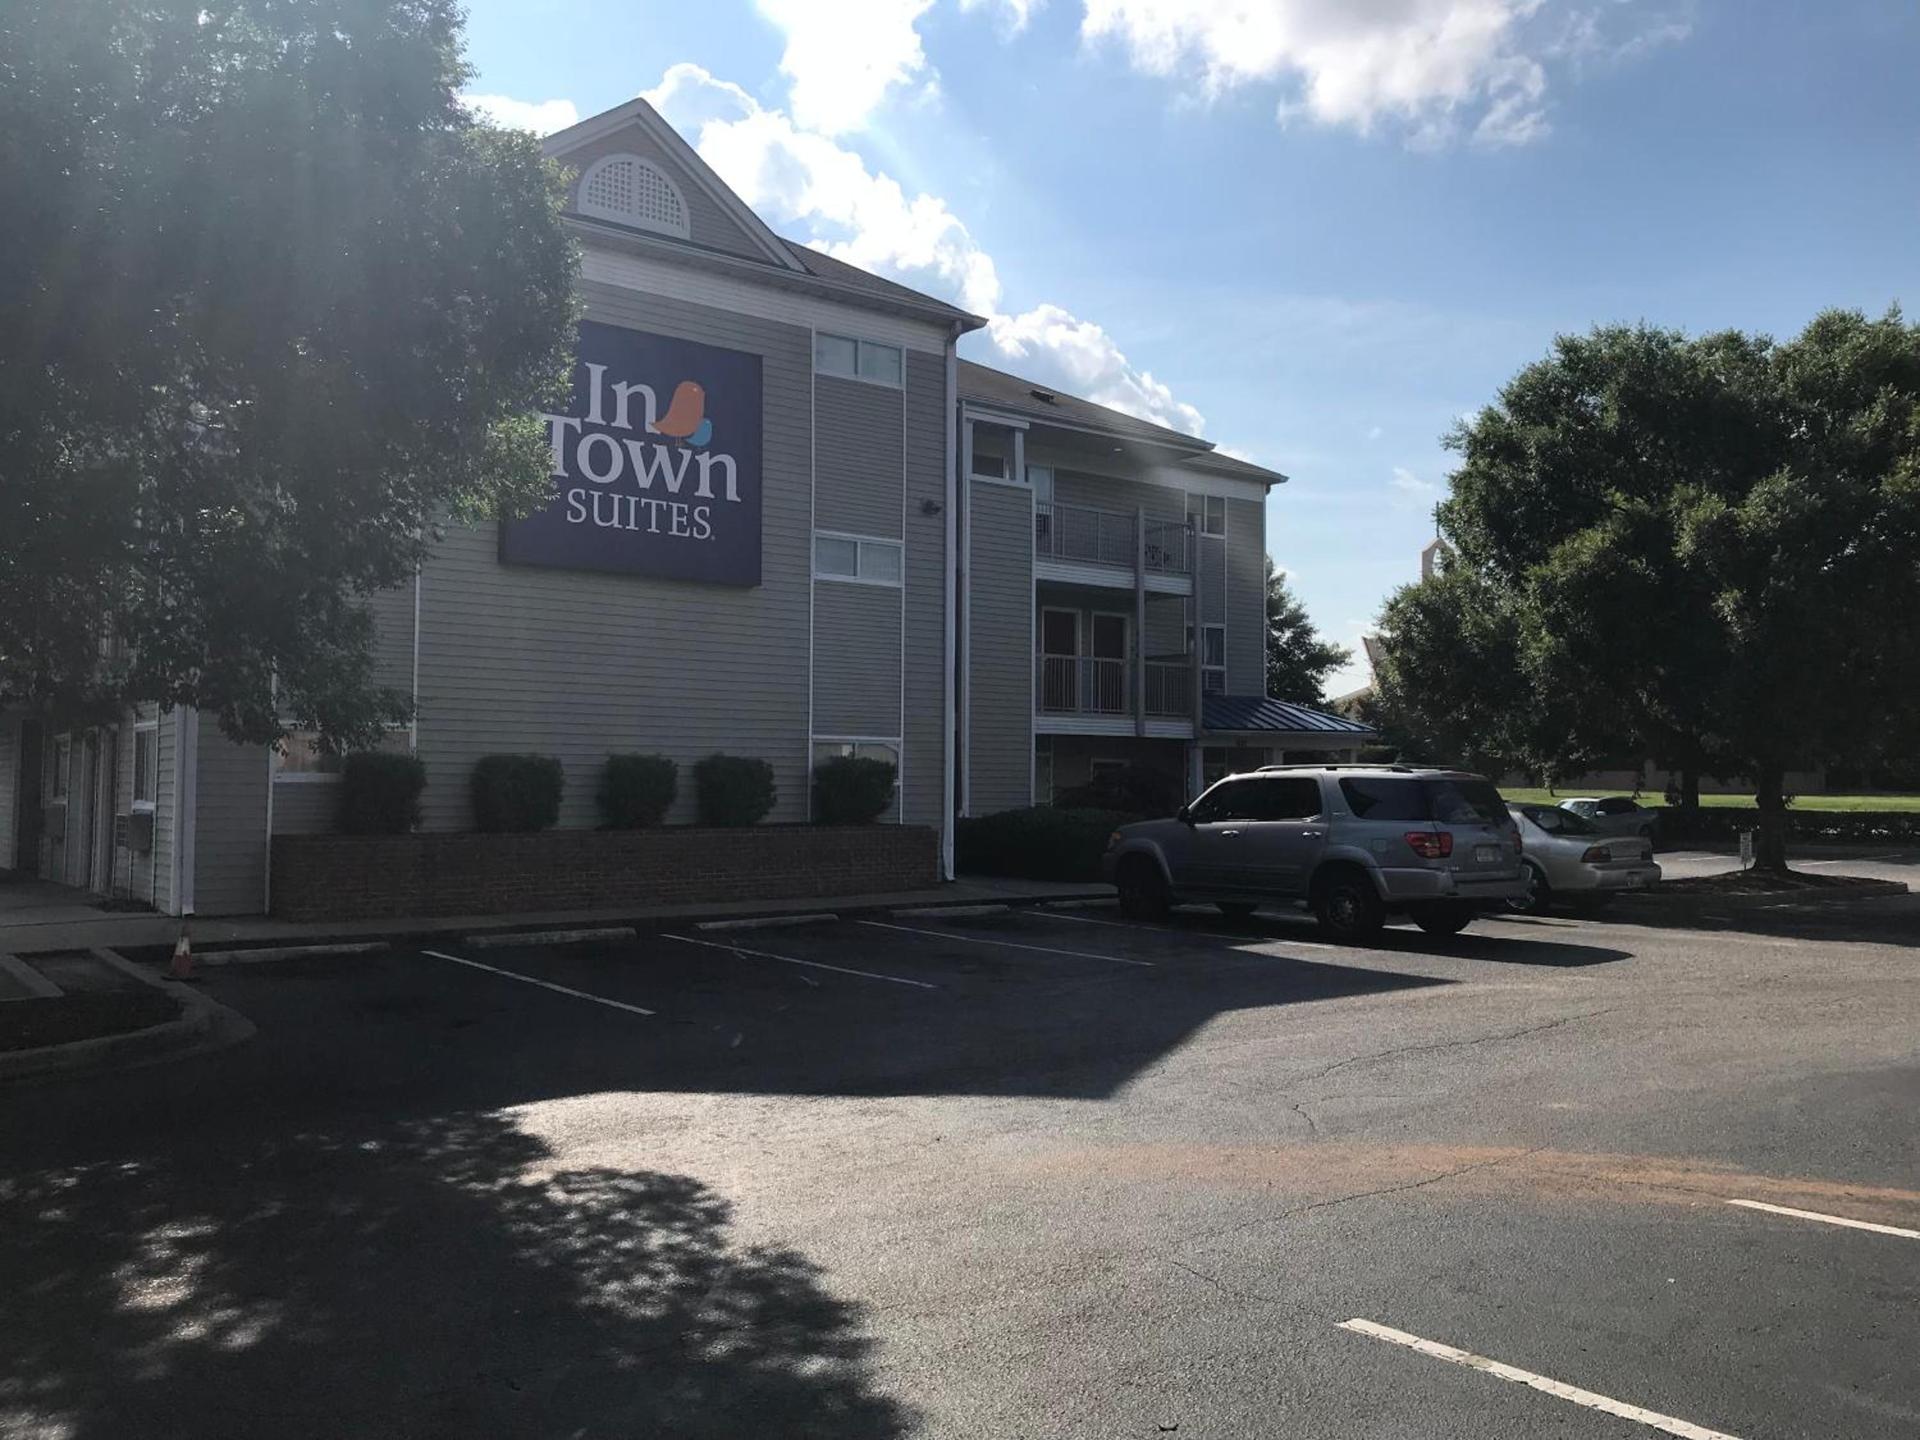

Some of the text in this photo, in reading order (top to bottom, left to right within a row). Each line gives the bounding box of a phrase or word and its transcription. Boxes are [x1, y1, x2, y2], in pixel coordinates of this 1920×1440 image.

[584, 361, 661, 435] In
[540, 413, 741, 502] Town
[566, 488, 712, 539] SUITES
